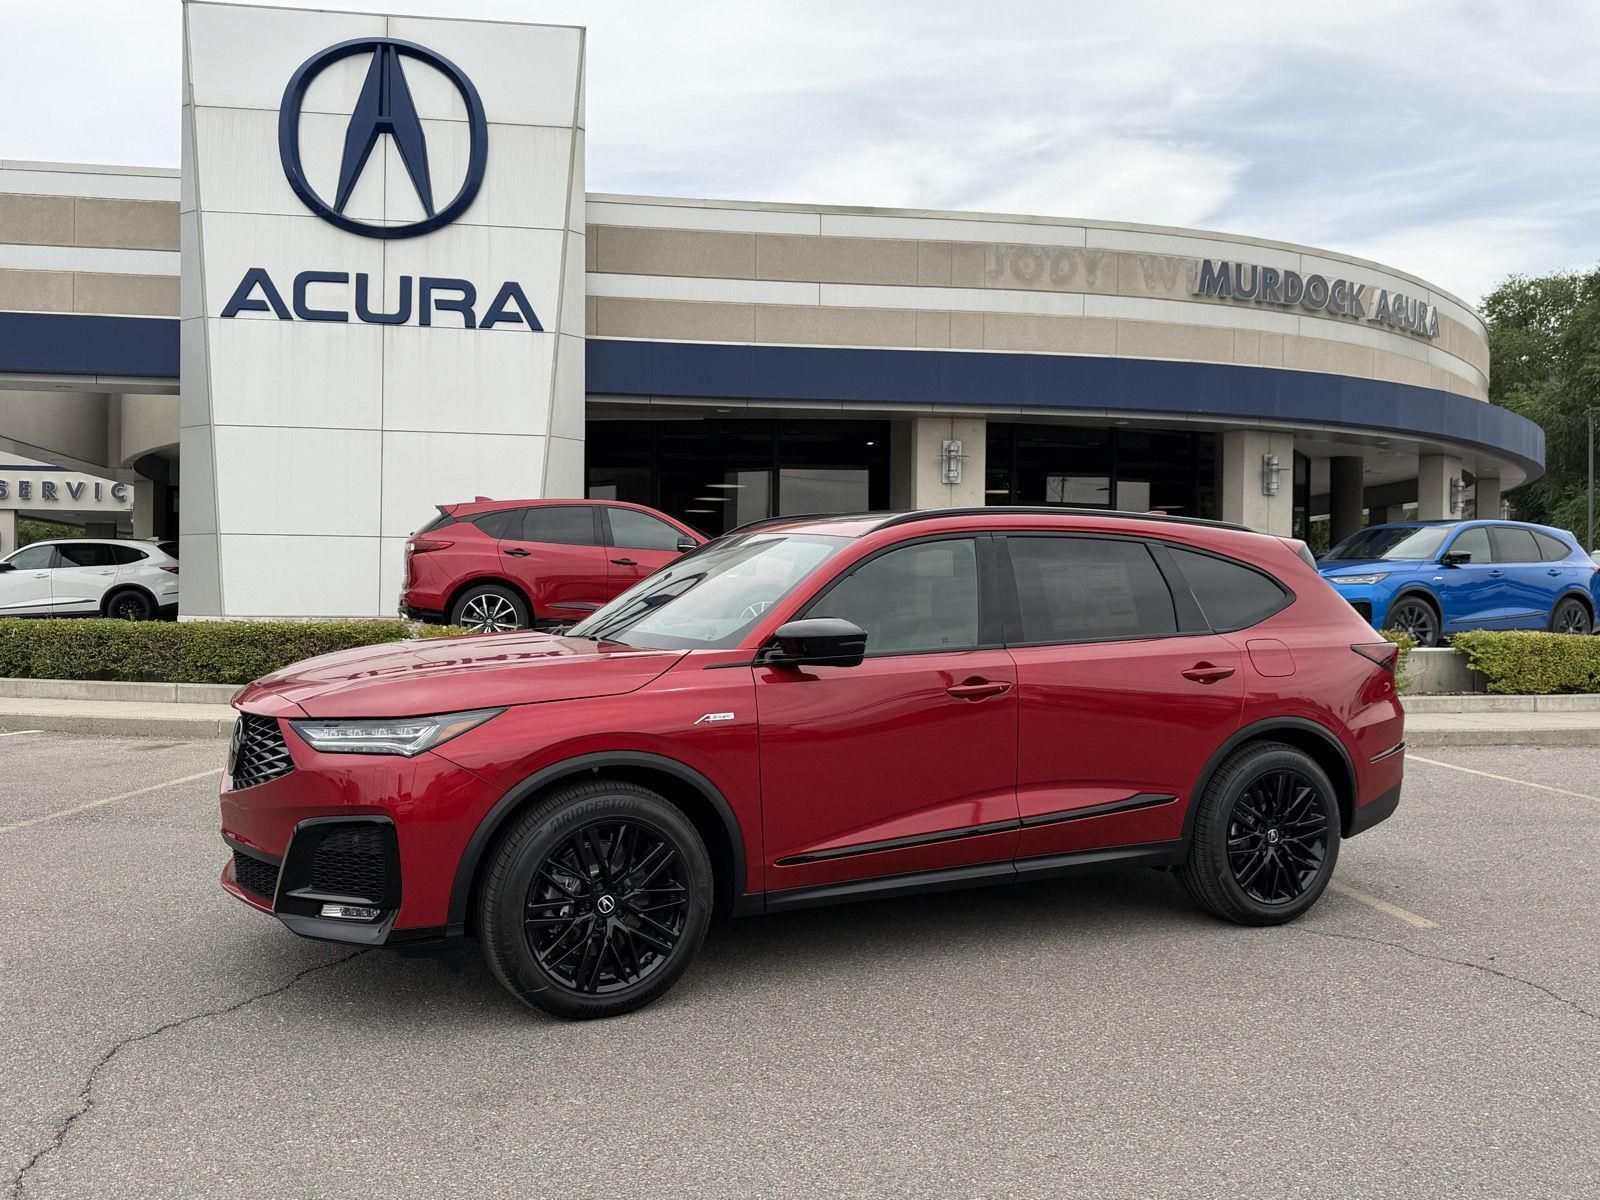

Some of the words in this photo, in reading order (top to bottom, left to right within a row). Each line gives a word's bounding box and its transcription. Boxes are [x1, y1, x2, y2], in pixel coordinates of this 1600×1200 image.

[220, 267, 544, 332] ACURA
[1196, 259, 1366, 319] MURDOCK
[1370, 288, 1440, 339] ACURA
